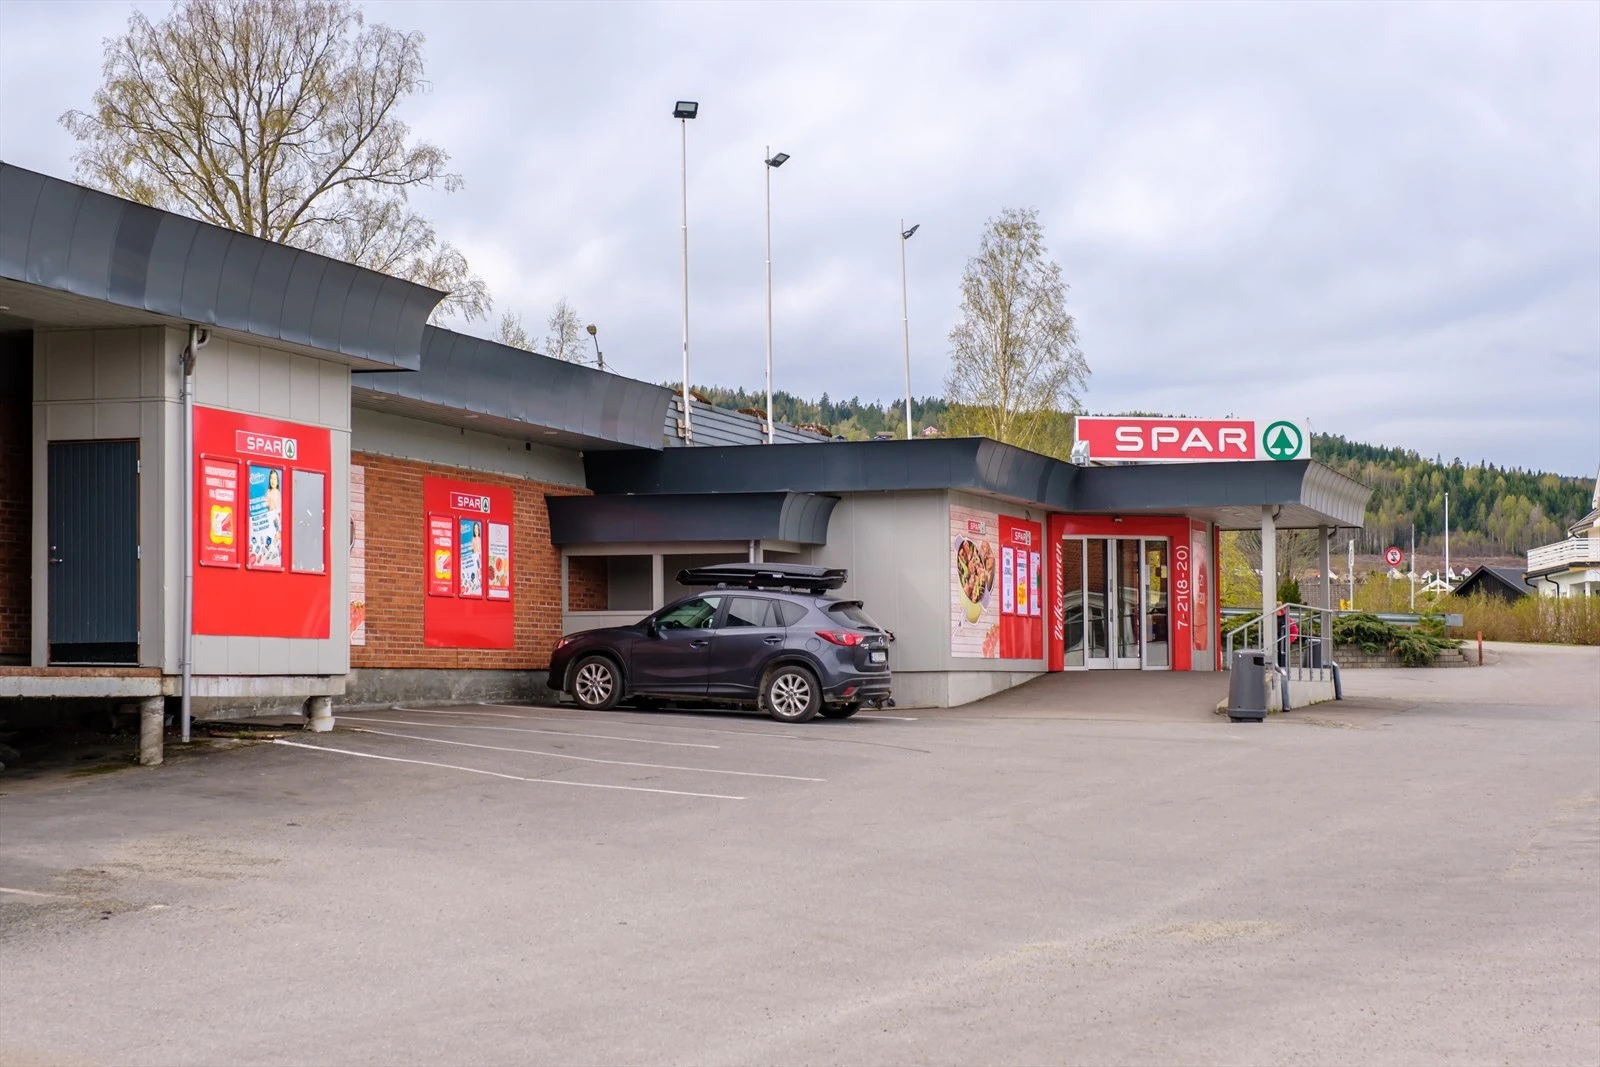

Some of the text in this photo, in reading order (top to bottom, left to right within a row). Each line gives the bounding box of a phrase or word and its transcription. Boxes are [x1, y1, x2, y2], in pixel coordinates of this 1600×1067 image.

[247, 436, 282, 453] SPAR
[1115, 426, 1247, 453] SPAR
[457, 496, 481, 508] SPAR
[1014, 531, 1026, 541] SPAR
[1054, 542, 1063, 641] Velkommen
